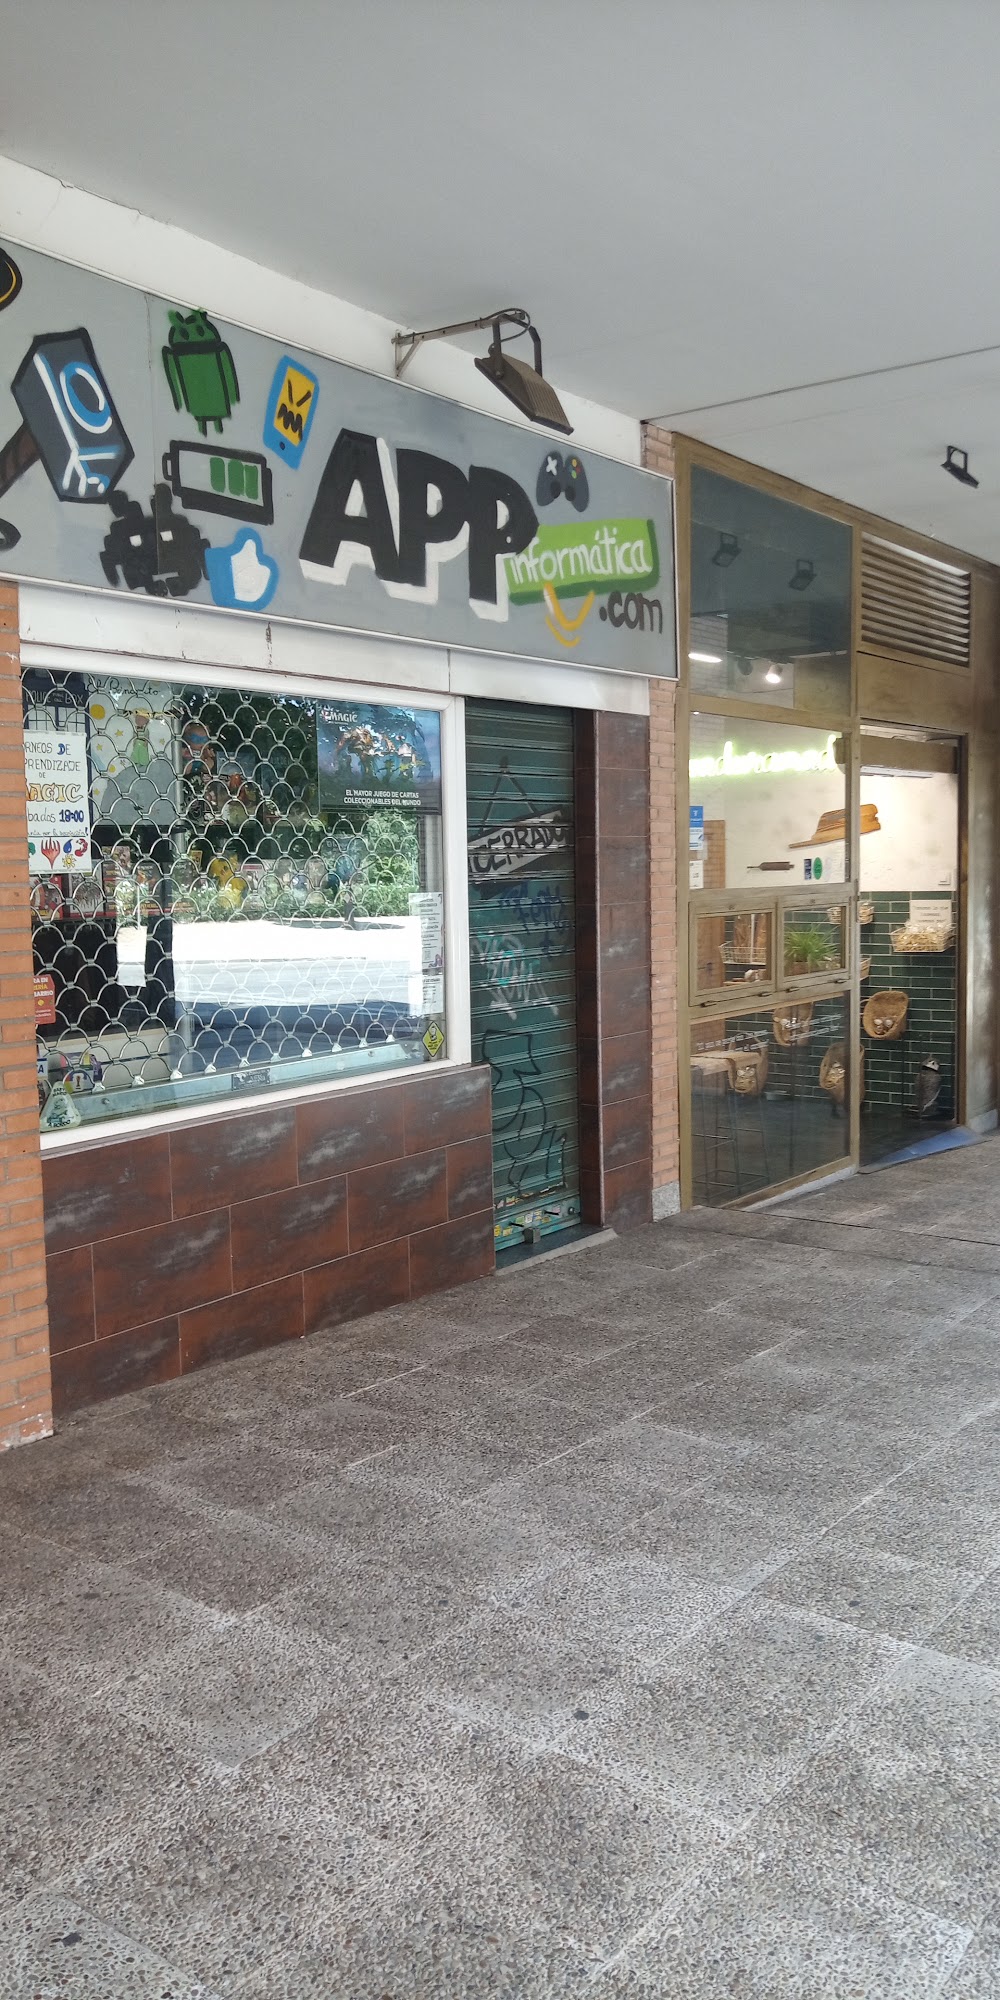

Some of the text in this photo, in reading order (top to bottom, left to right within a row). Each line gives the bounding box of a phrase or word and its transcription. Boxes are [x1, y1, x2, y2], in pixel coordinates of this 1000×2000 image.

[299, 428, 540, 617] APP
[509, 526, 653, 585] informática
[599, 590, 663, 634] .com
[330, 711, 358, 723] MAGIC
[57, 743, 71, 755] DE
[343, 796, 391, 805] COLECCIONABLES
[353, 789, 373, 797] MAYOR
[373, 790, 391, 798] JUEGO
[399, 791, 419, 799] CARTAS
[59, 809, 85, 823] 18:00
